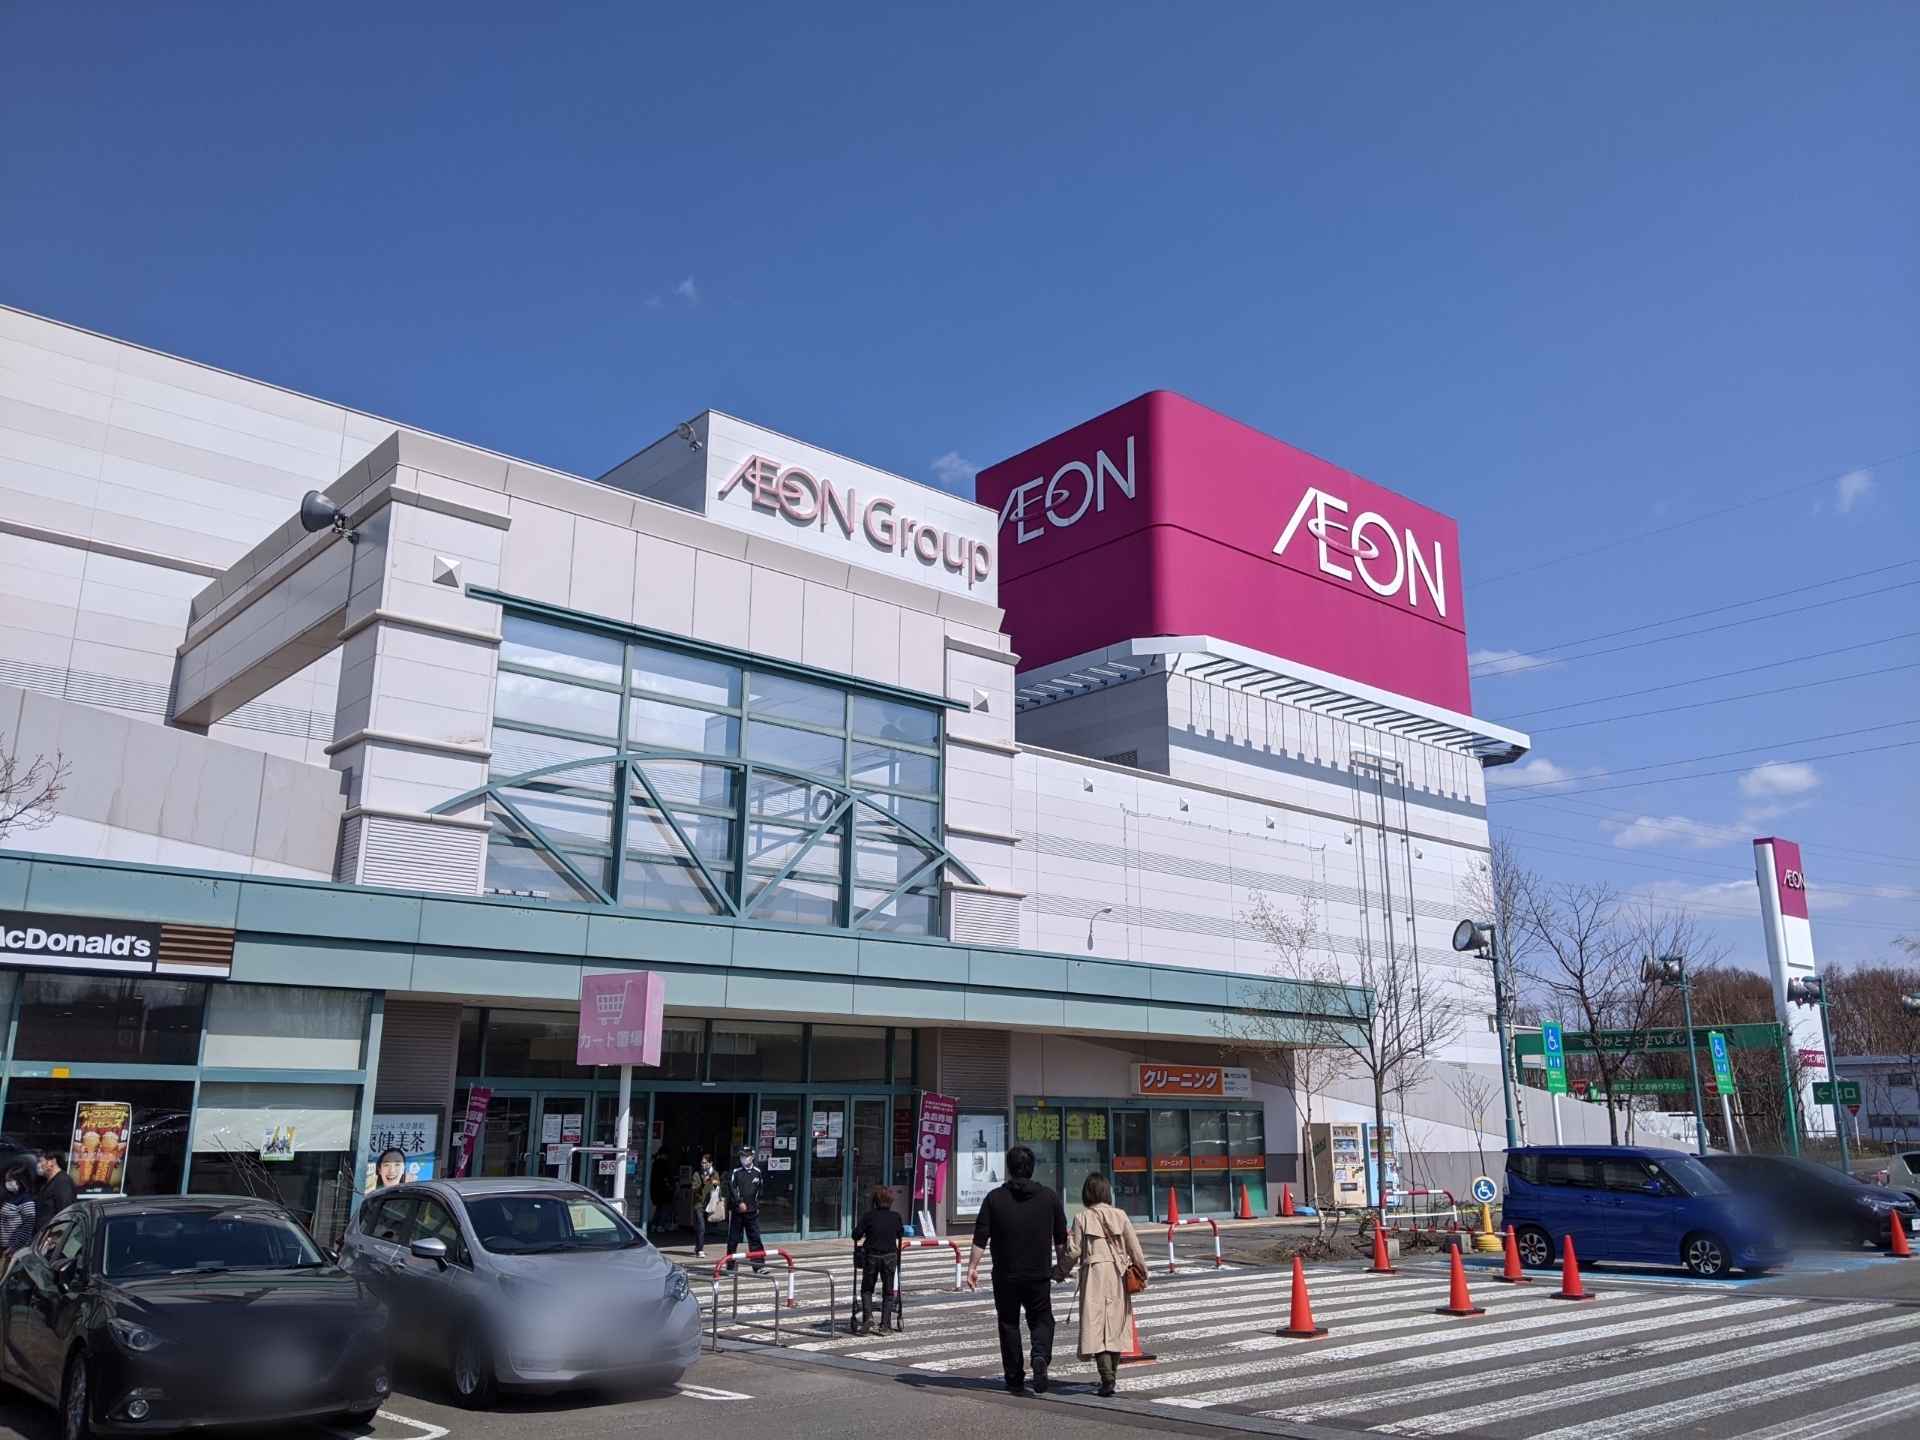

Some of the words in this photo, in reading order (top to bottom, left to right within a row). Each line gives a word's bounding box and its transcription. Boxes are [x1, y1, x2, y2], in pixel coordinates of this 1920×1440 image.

[864, 497, 993, 585] Group
[0, 925, 151, 957] cDonald's
[579, 1030, 643, 1049] カート置場
[1143, 1069, 1218, 1090] クリーニング
